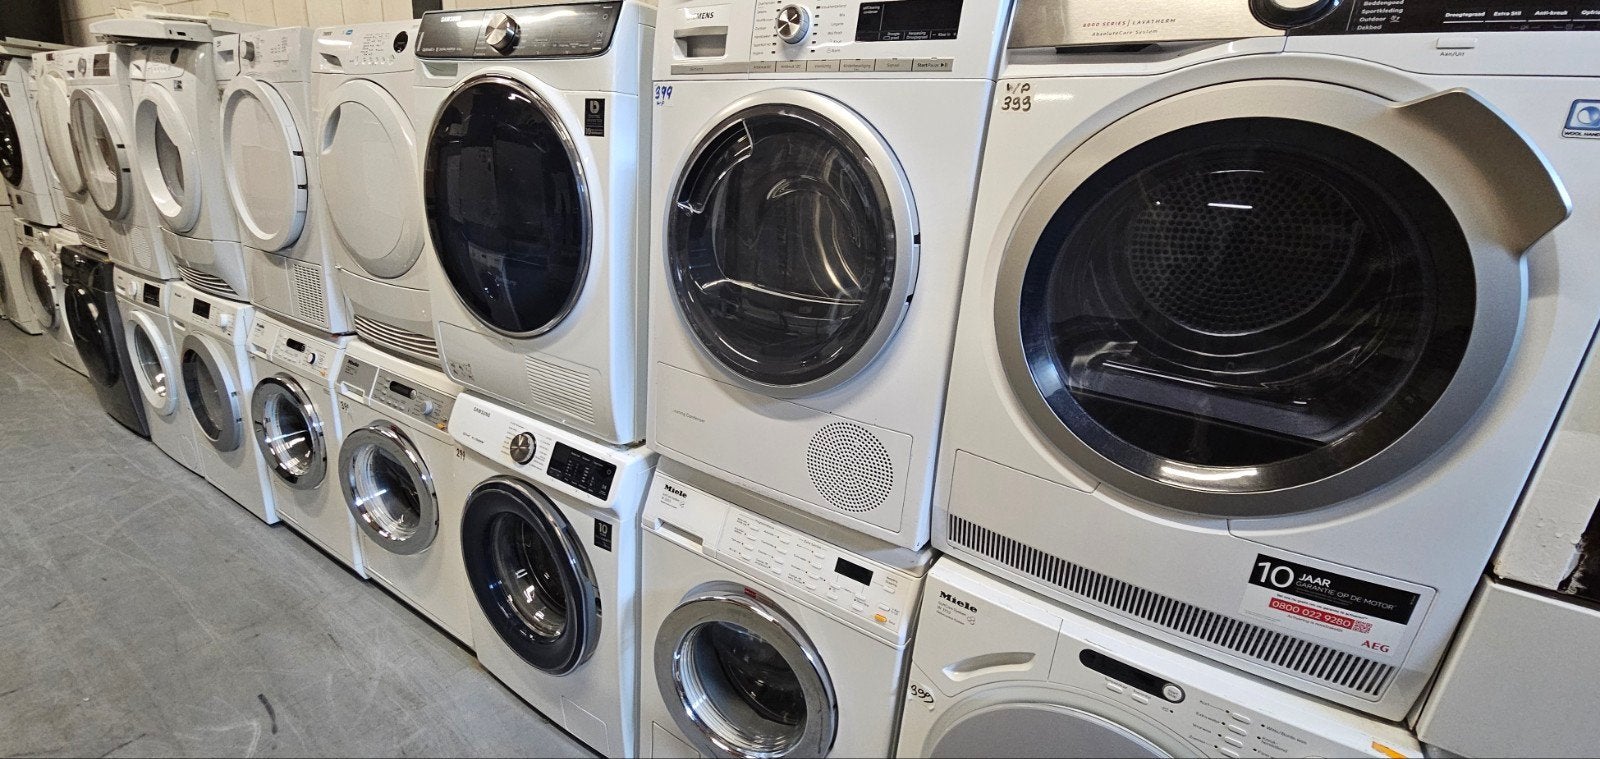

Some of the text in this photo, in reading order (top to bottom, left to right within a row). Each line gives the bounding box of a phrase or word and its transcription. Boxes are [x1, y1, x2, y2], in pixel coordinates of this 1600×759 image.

[663, 484, 687, 499] Miele
[1257, 561, 1332, 588] 10 JAAR
[939, 590, 978, 613] Miele
[1295, 580, 1335, 595] GARANTIE
[1335, 591, 1350, 600] OP
[1350, 594, 1362, 603] DE
[1271, 599, 1351, 628] 0800 022 9280
[1360, 639, 1390, 653] AEG
